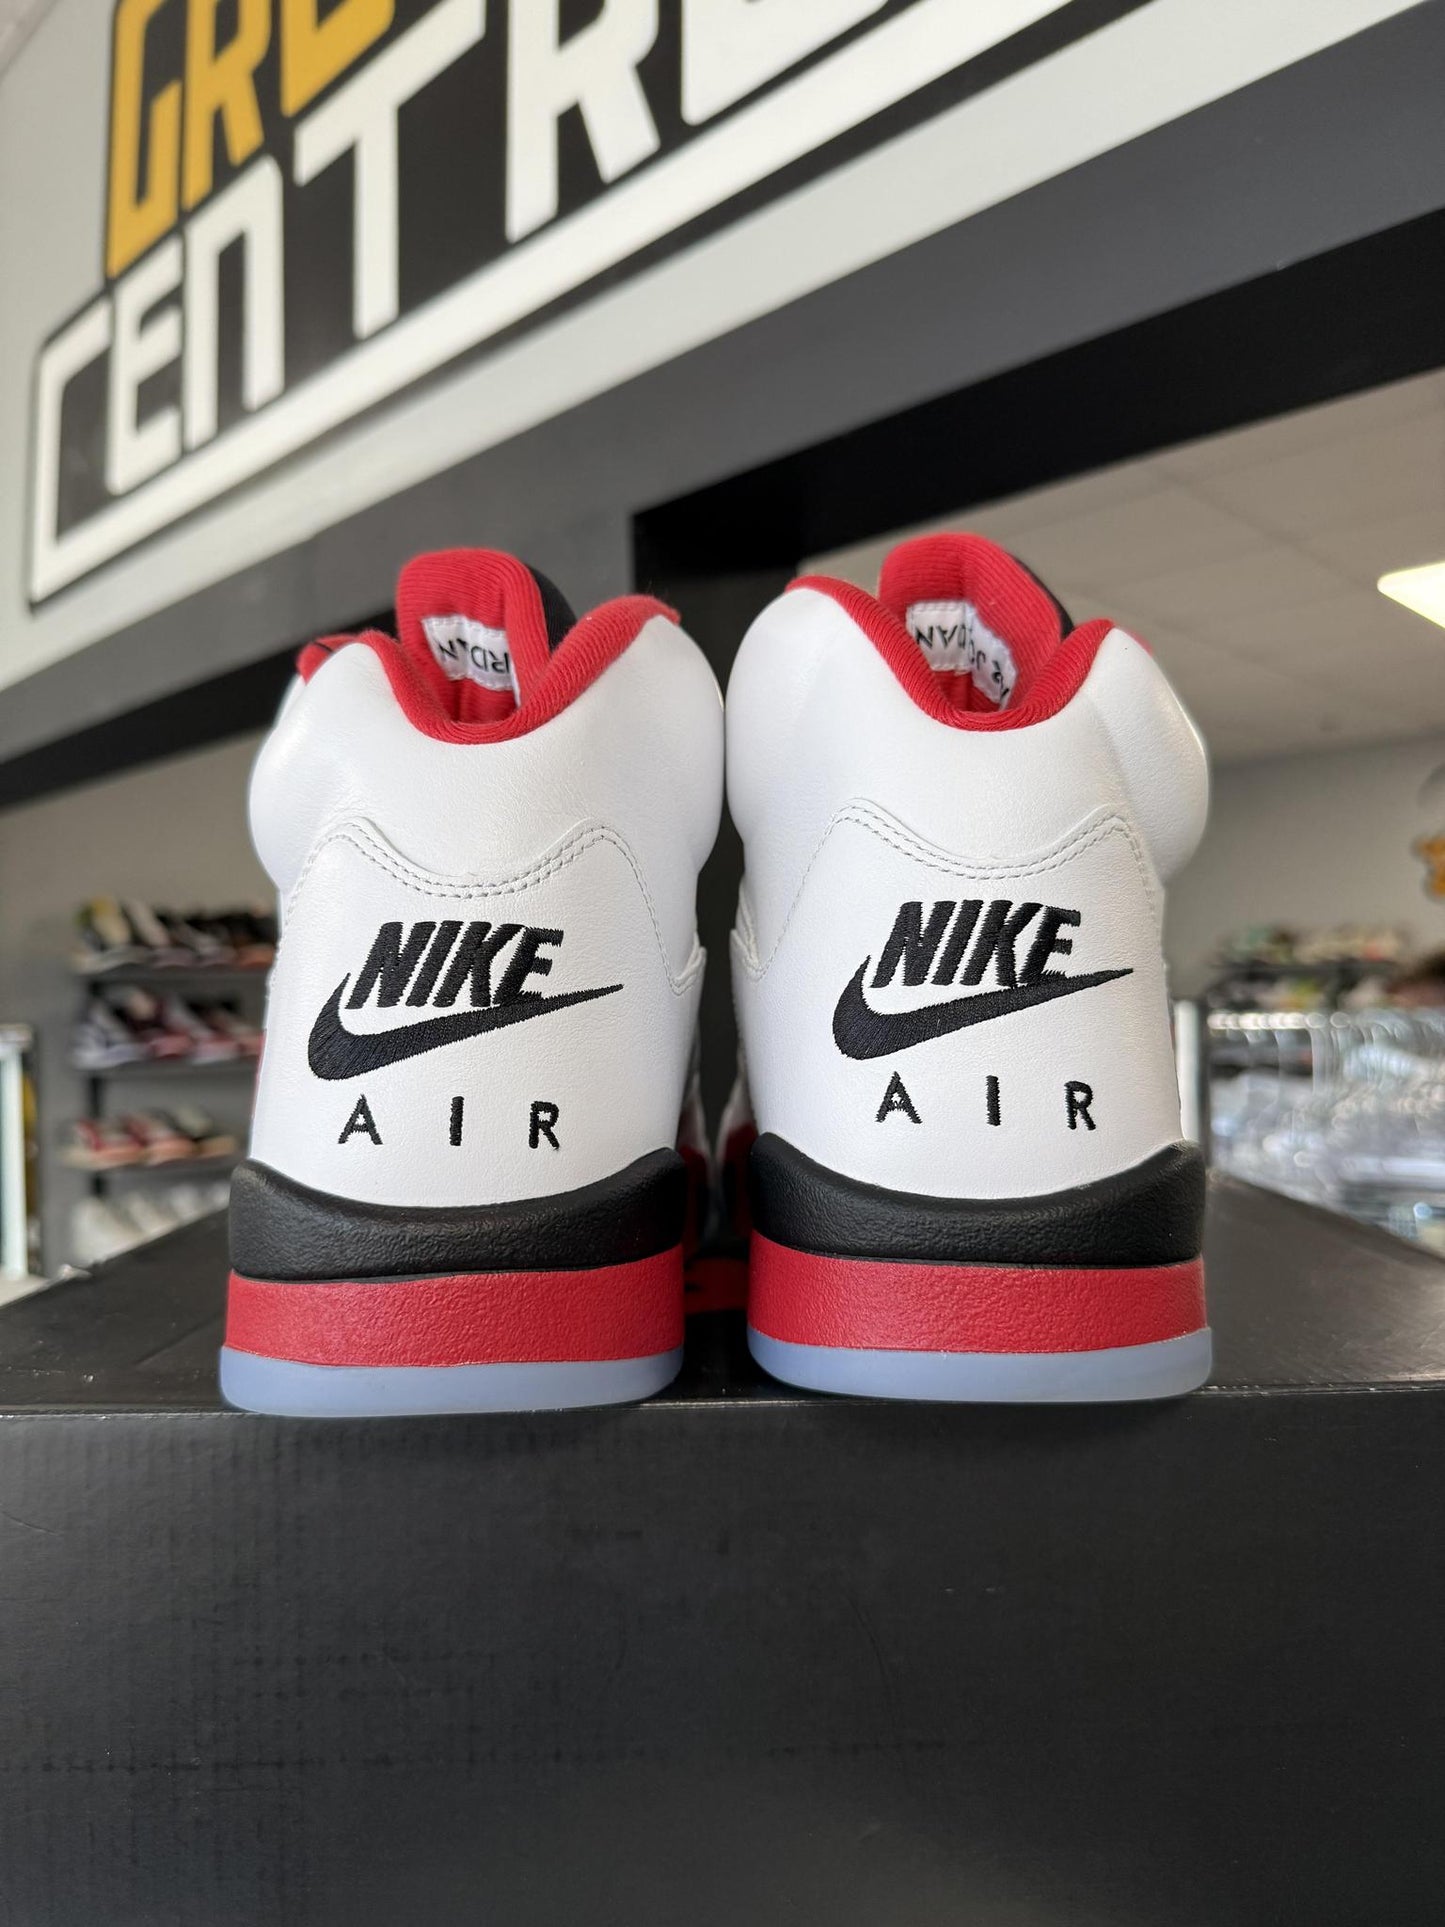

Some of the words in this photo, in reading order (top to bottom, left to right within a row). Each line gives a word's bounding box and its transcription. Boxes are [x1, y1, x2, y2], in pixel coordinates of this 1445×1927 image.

[344, 920, 564, 1010] NIKE
[869, 899, 1082, 989] NIKE
[338, 1094, 560, 1150] AIR
[875, 1071, 1097, 1131] AIR
